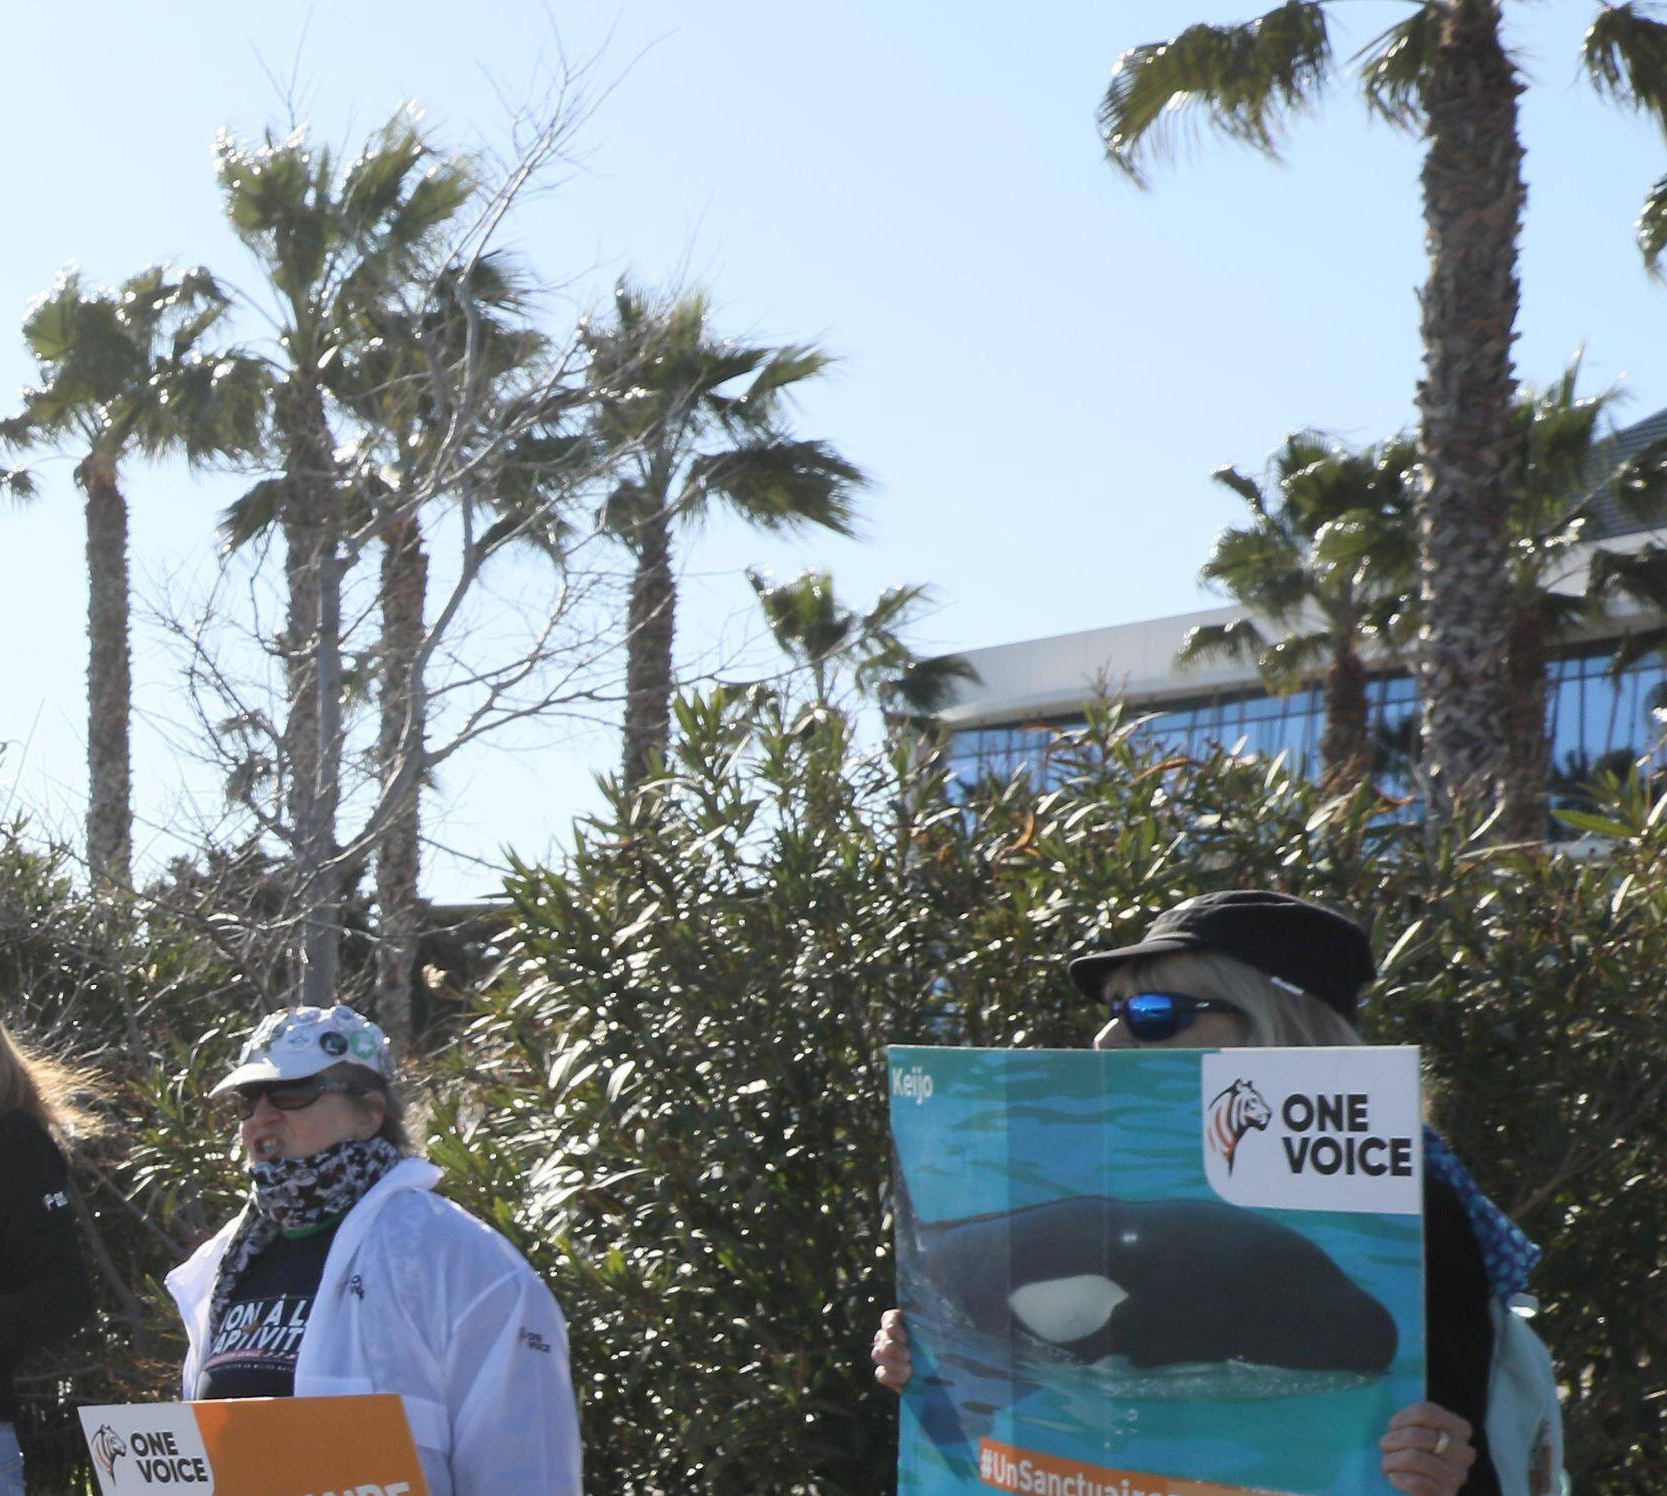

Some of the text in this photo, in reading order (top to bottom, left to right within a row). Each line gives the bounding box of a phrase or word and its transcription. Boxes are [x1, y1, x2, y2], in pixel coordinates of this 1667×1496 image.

[892, 1068, 934, 1104] Keijo
[1281, 1093, 1369, 1132] ONE
[1281, 1136, 1413, 1177] VOICE
[262, 1293, 287, 1326] À
[130, 1431, 179, 1457] ONE
[136, 1456, 208, 1484] VOICE
